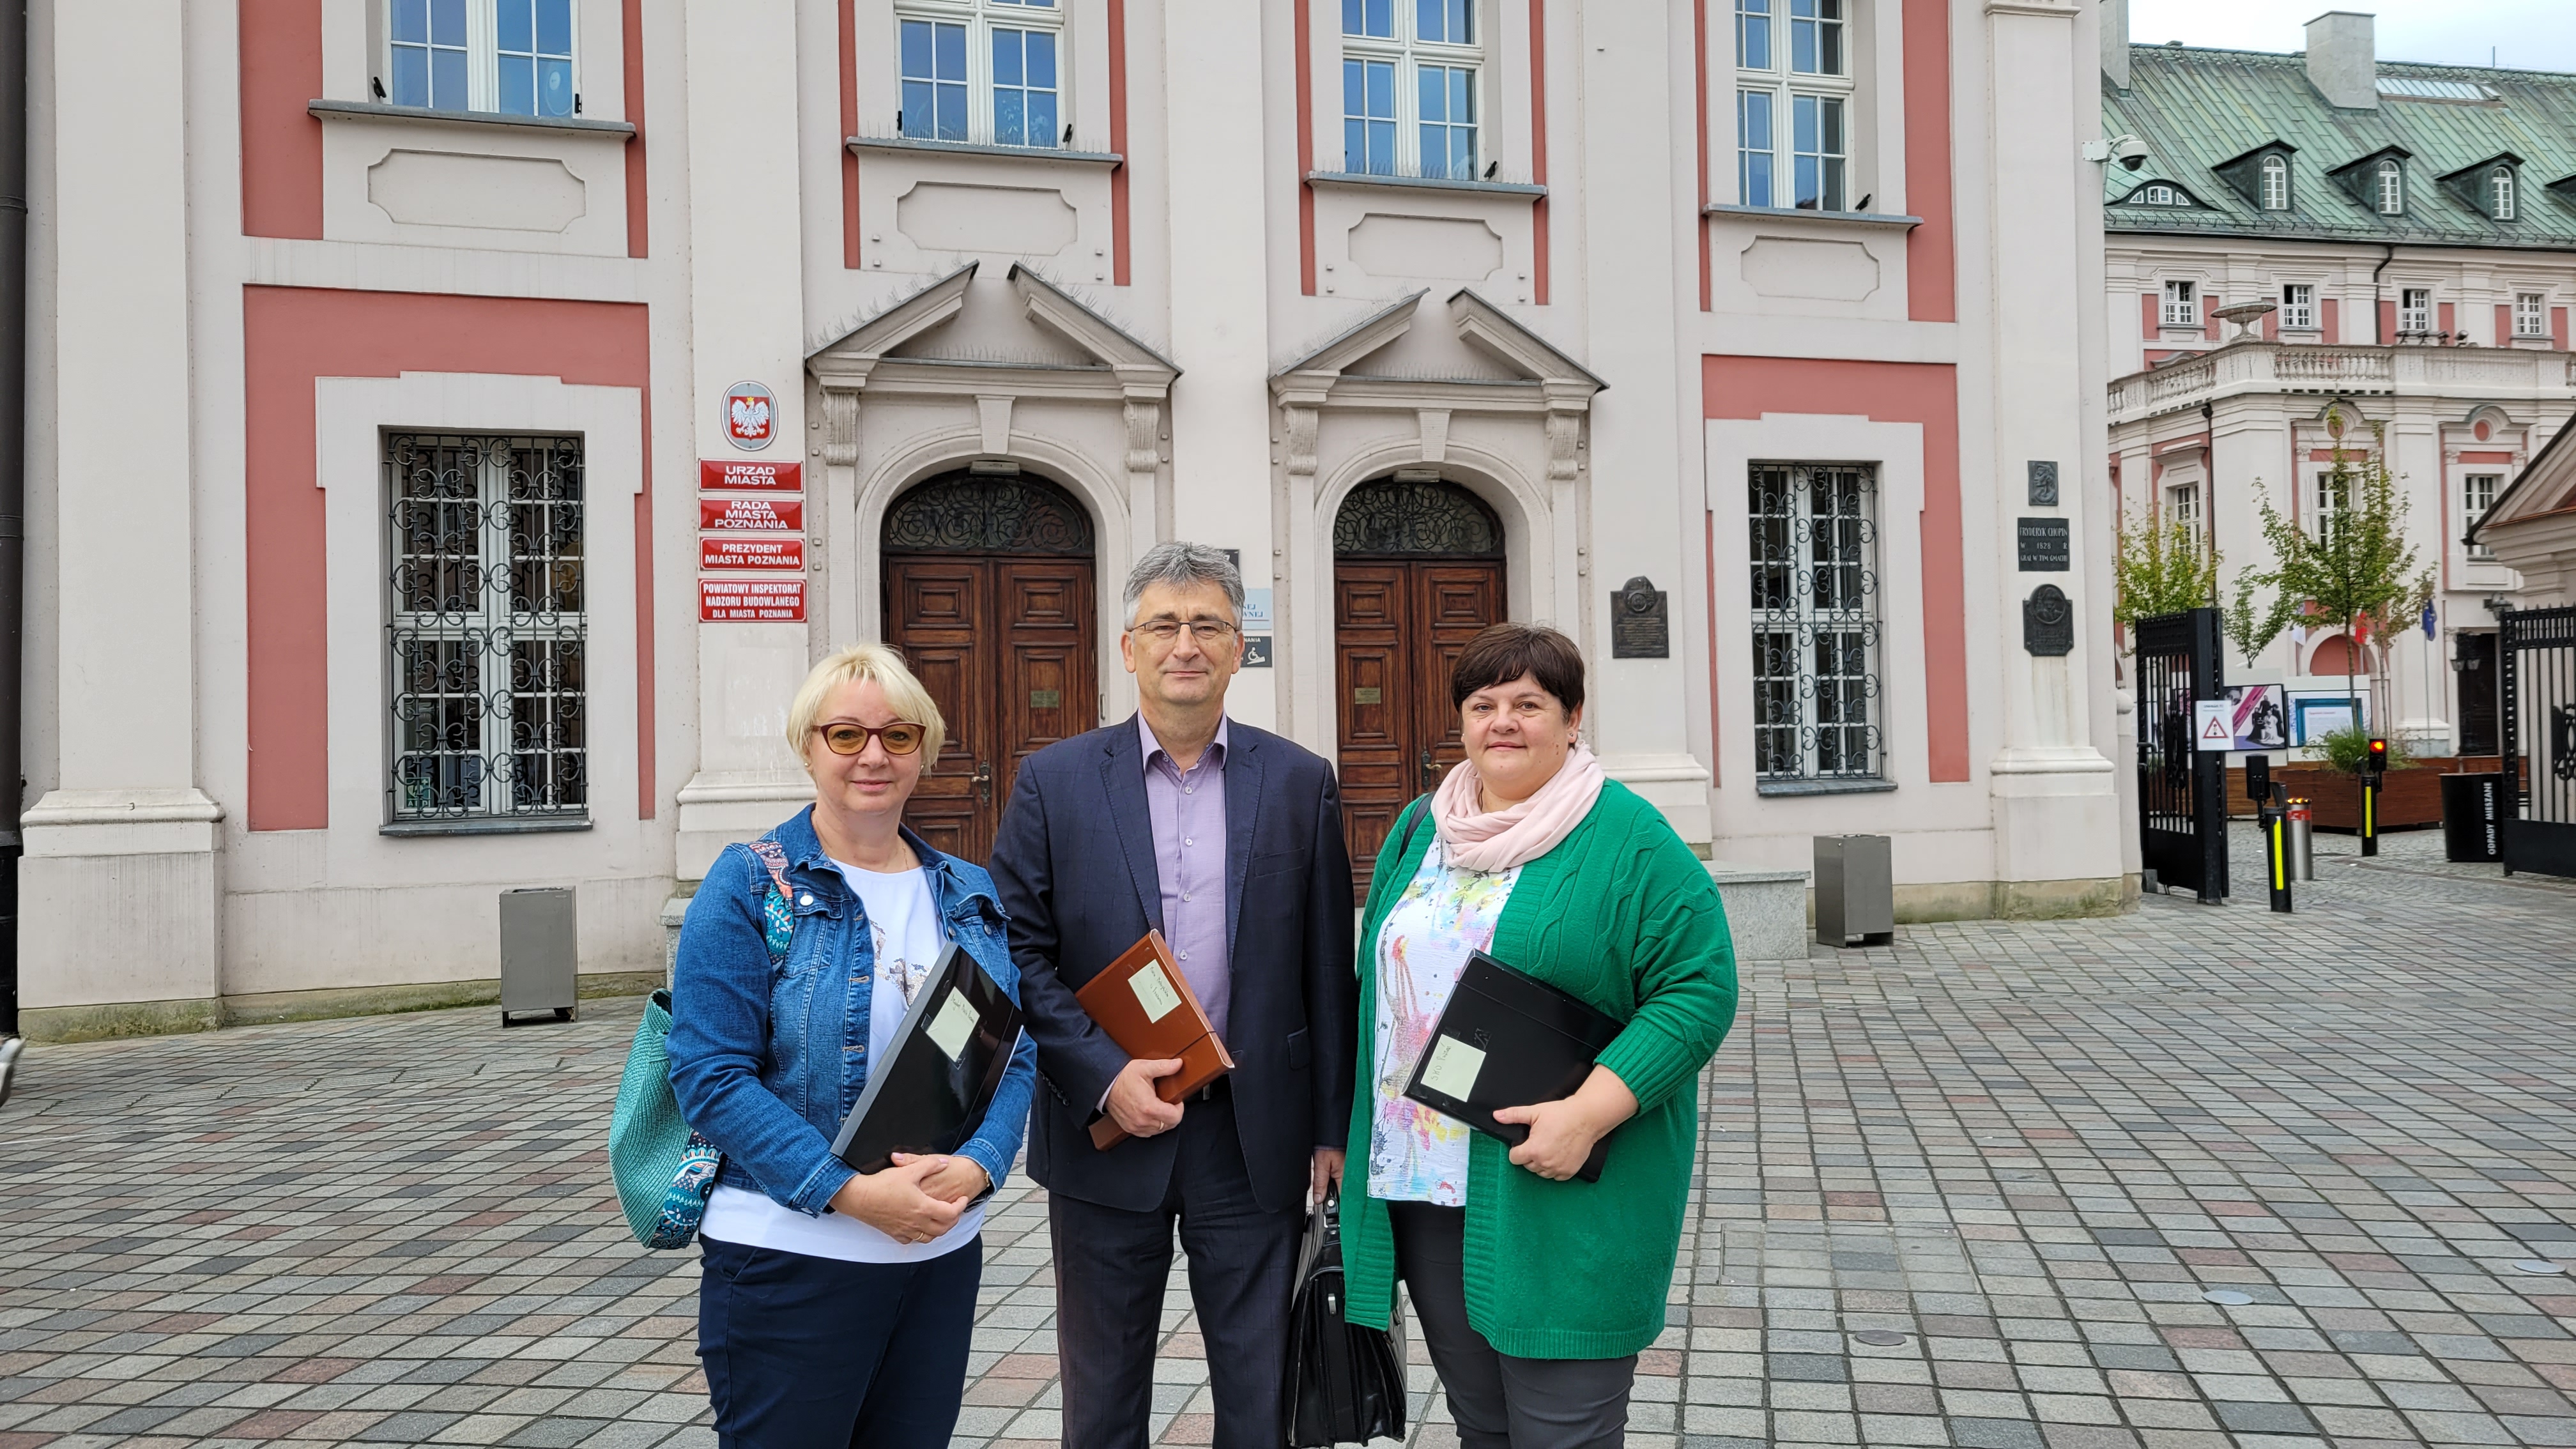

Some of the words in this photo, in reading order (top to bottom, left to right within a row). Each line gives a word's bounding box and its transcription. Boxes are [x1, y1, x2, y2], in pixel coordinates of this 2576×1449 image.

[725, 465, 776, 476] URZĄD
[724, 475, 776, 485] MIASTA
[731, 501, 771, 510] RADA
[725, 510, 777, 519] MIASTA
[714, 519, 788, 529] POZNANIA
[2020, 527, 2046, 537] FRYDERYK
[2048, 527, 2067, 537] CHOPIN
[722, 544, 783, 554] PREZYDENT
[705, 555, 744, 564] MIASTA
[747, 555, 800, 565] POZNANIA
[703, 583, 749, 594] POWIATOWY
[751, 584, 801, 594] INSPEKTORAT
[705, 596, 741, 606] NADZORU
[743, 596, 800, 606] BUDOWLANEGO
[712, 609, 726, 618] DLA
[730, 609, 756, 618] MIASTA
[759, 609, 793, 618] POZNANIA
[2483, 783, 2494, 820] MIESZANE
[2486, 824, 2496, 855] ODPADY
